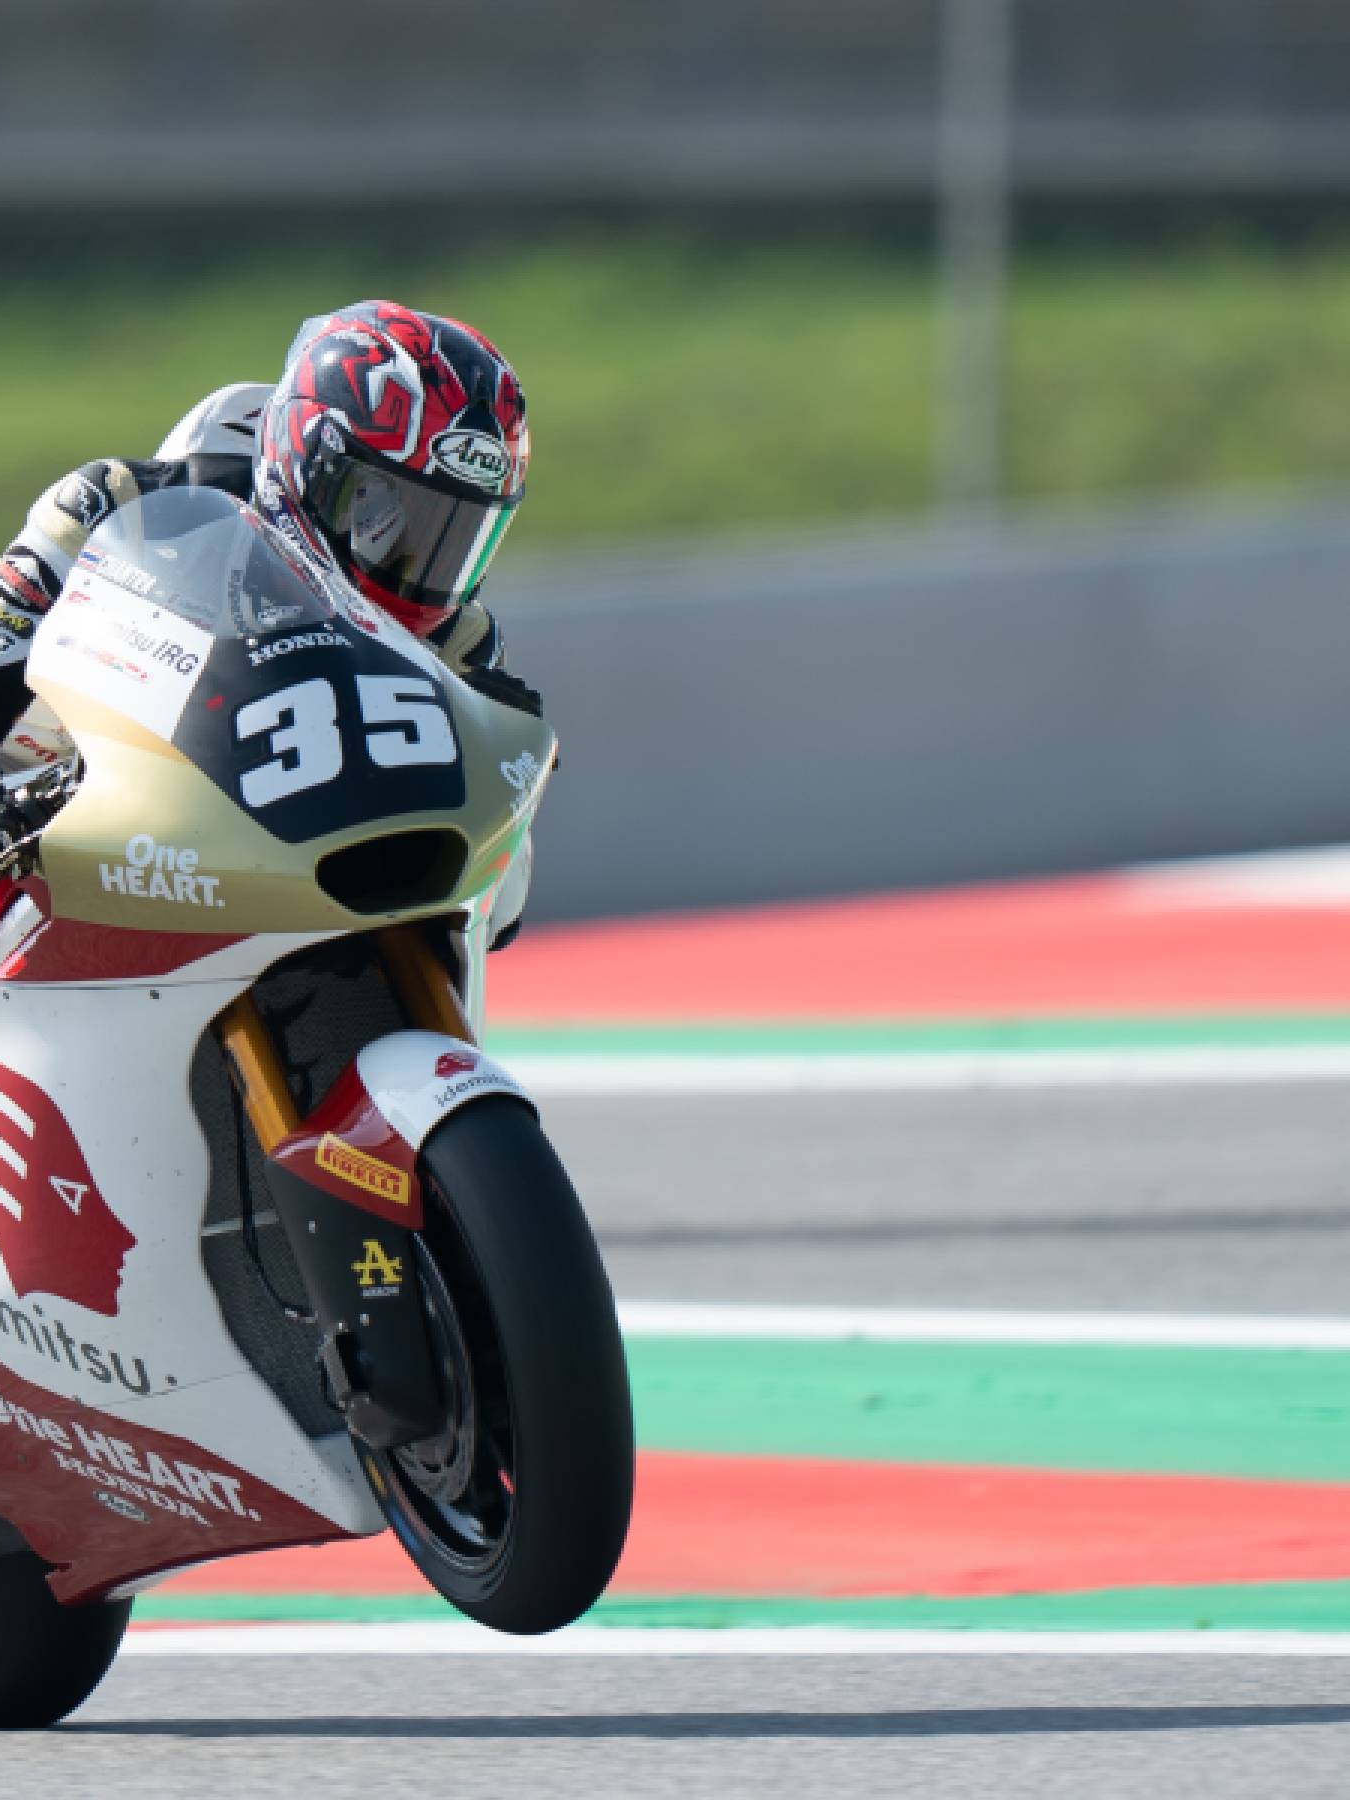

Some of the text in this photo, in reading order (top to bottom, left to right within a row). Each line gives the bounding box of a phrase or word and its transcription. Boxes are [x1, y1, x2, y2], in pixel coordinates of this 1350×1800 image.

[438, 435, 501, 472] Arai
[152, 638, 201, 676] IRG
[248, 632, 354, 667] HONDA
[236, 674, 458, 808] 35
[125, 832, 199, 873] One
[98, 863, 226, 908] HEART.
[323, 1141, 403, 1195] PIRELLI
[51, 1449, 213, 1527] HONDA
[70, 1420, 262, 1521] HEART.
